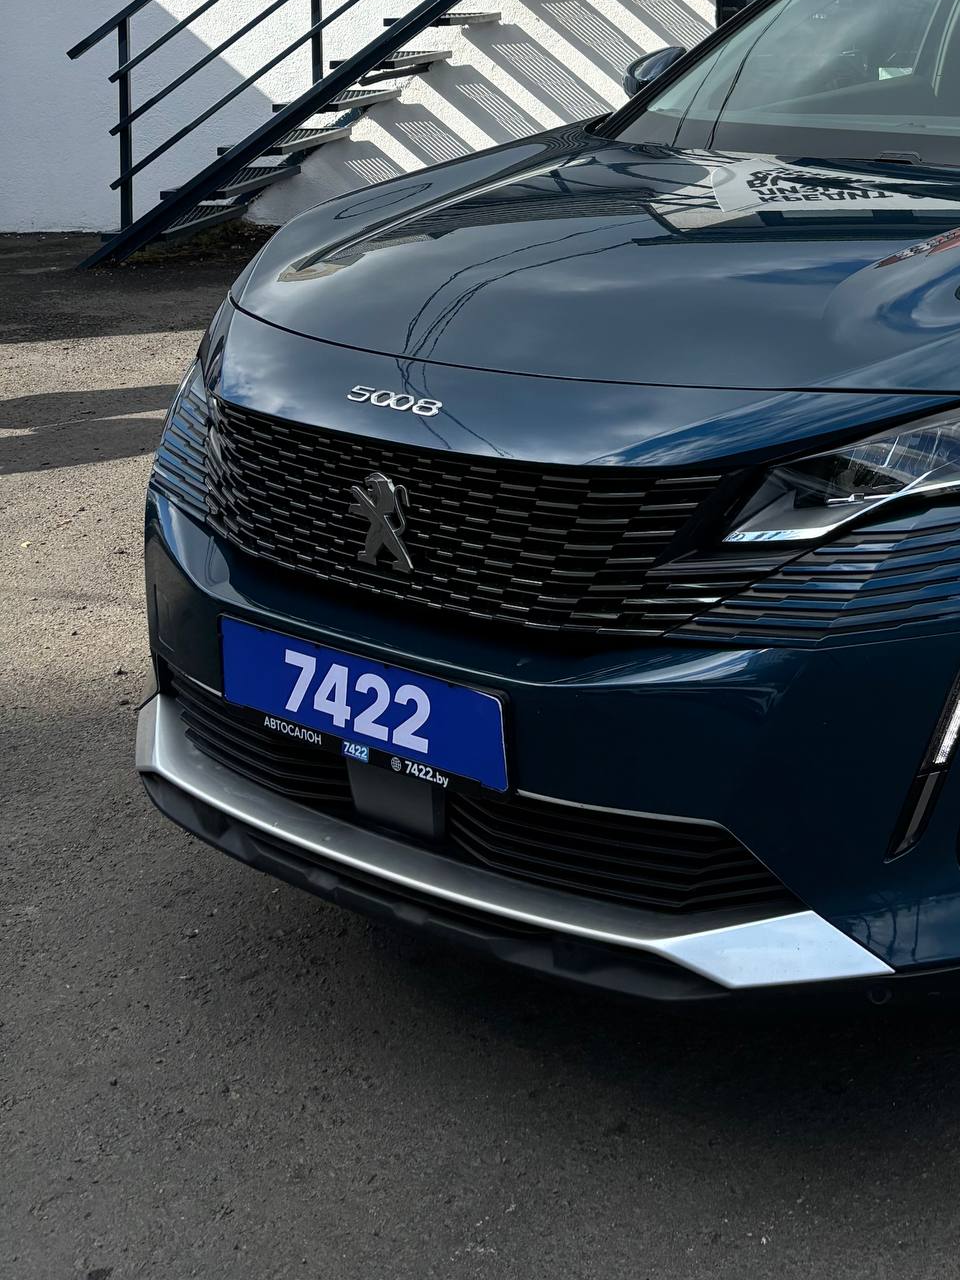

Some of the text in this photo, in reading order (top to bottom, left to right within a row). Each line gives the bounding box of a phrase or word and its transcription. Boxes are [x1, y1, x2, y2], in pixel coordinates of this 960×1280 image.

[346, 384, 443, 417] 5008
[284, 648, 431, 754] 7422
[263, 716, 322, 746] АВТОСАЛОН
[343, 741, 368, 759] 7422
[404, 760, 449, 788] 7422.by
